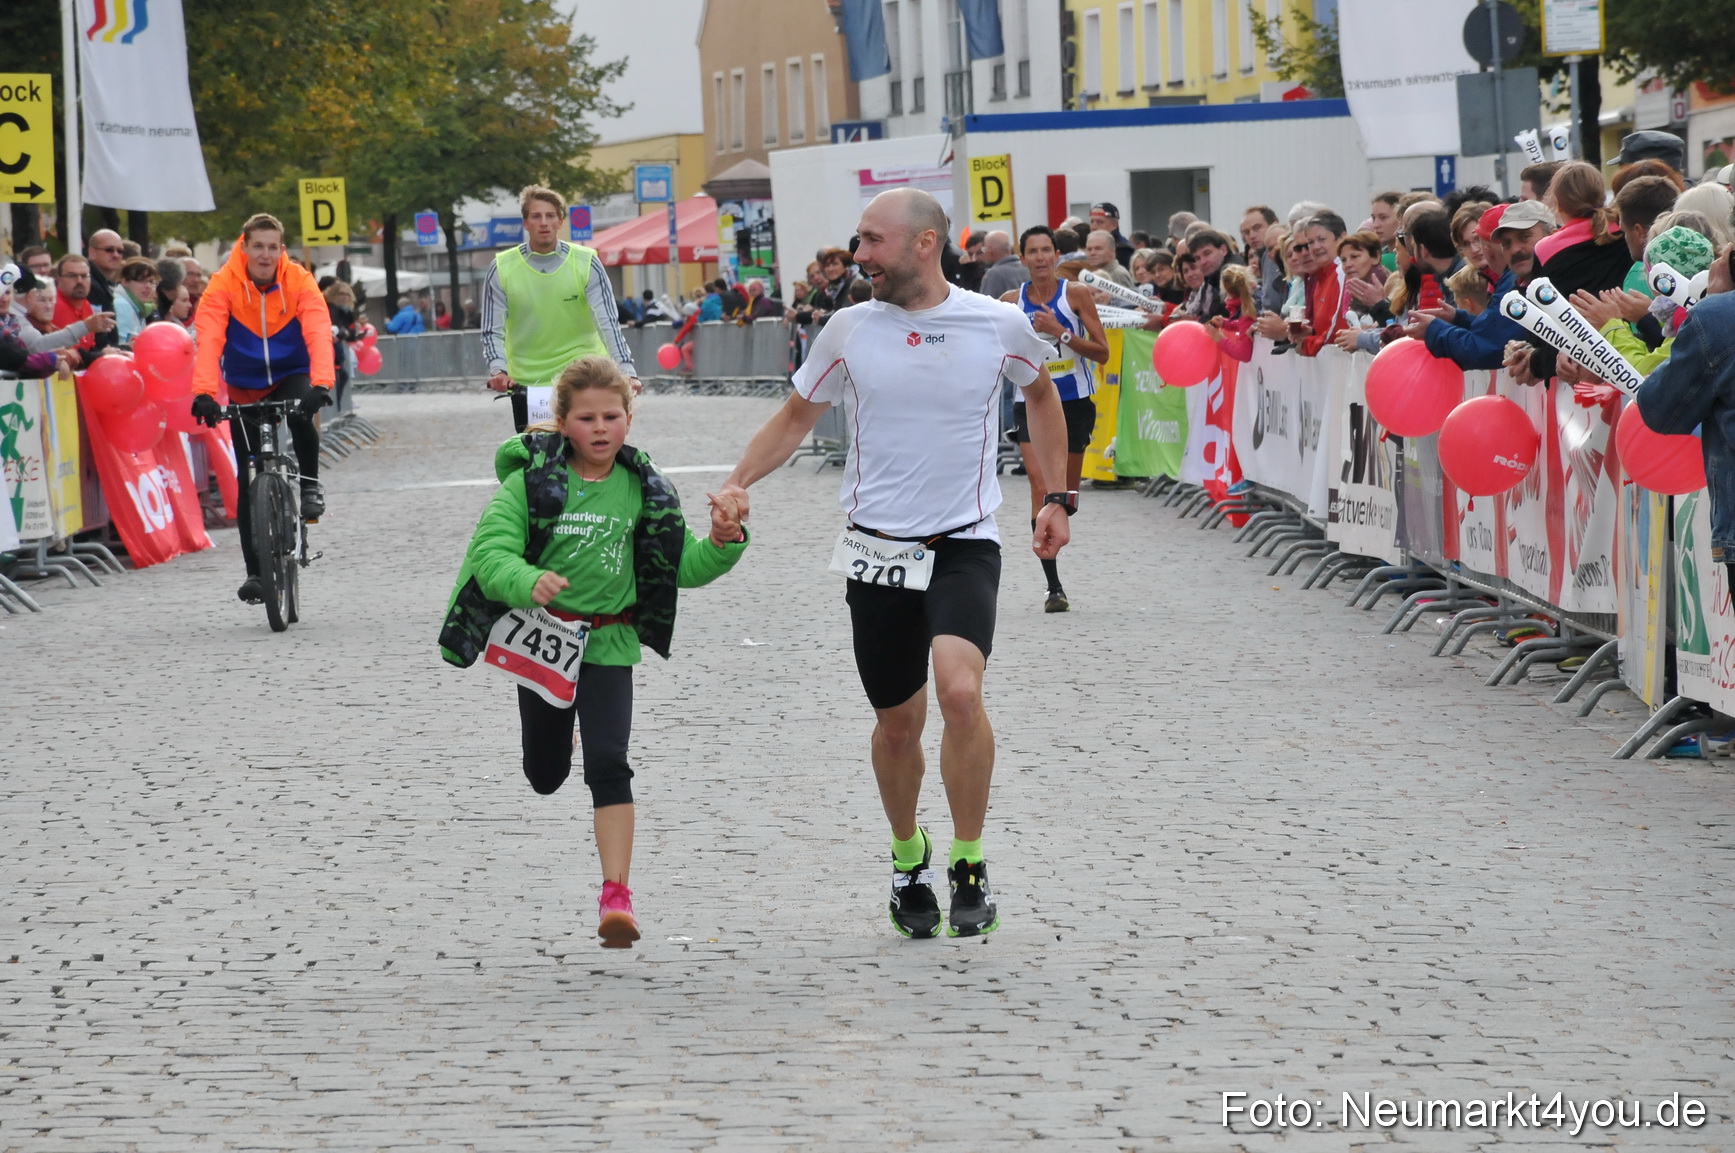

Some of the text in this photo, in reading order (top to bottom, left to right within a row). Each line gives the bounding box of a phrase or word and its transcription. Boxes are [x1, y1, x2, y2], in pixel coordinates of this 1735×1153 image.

[0, 113, 31, 174] C
[973, 157, 1006, 171] Block
[305, 182, 340, 194] Block
[981, 175, 1003, 207] D
[313, 199, 335, 231] D
[1098, 279, 1158, 313] BMW Laufsport
[925, 333, 945, 345] dpd
[843, 537, 871, 557] PARTL
[536, 613, 580, 639] Neumarkt
[504, 612, 580, 673] 7437
